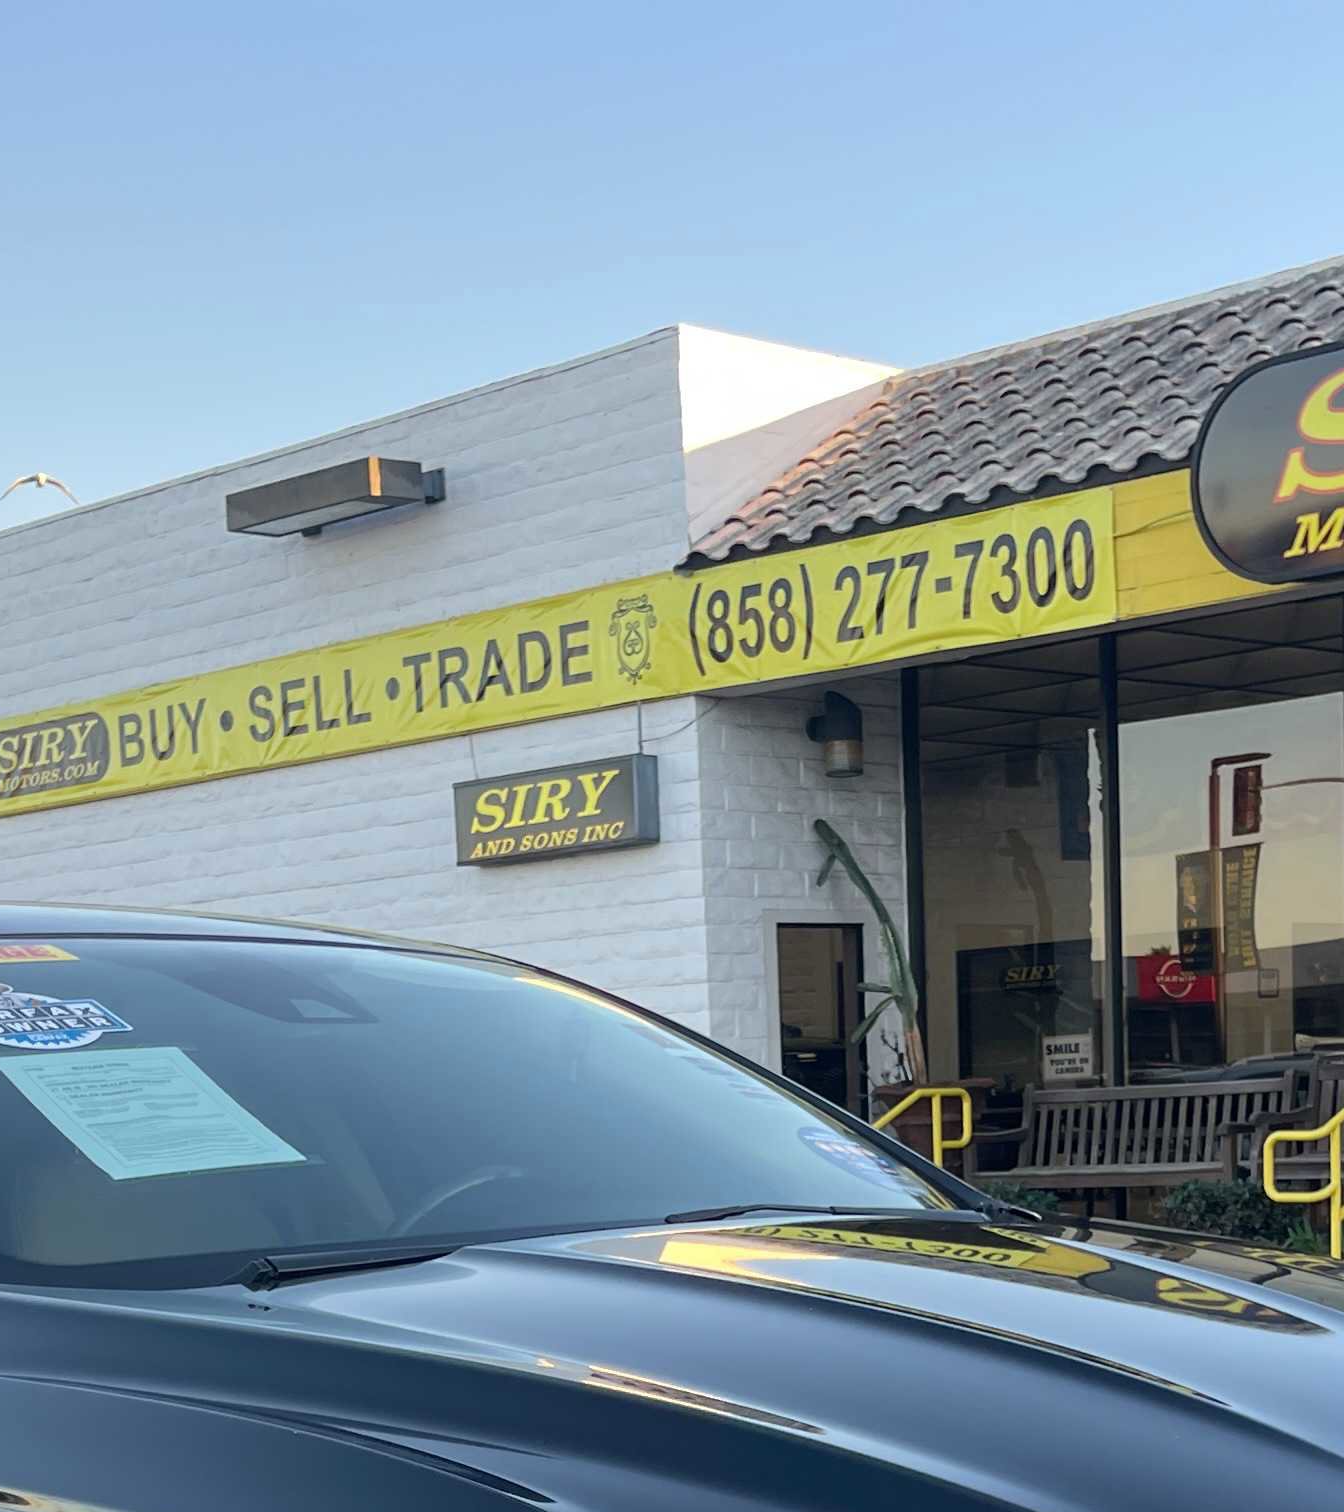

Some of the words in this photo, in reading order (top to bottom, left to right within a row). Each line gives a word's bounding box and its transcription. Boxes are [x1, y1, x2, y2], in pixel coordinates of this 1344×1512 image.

[689, 563, 813, 676] (858)
[836, 518, 1096, 643] 277-7300
[120, 698, 207, 767] BUY
[249, 669, 371, 742] SELL
[403, 620, 593, 712] TRADE
[470, 769, 619, 834] SIRY
[469, 836, 517, 859] AND
[520, 828, 580, 851] SONS
[585, 821, 625, 841] INC
[1046, 1043, 1080, 1055] SMILE
